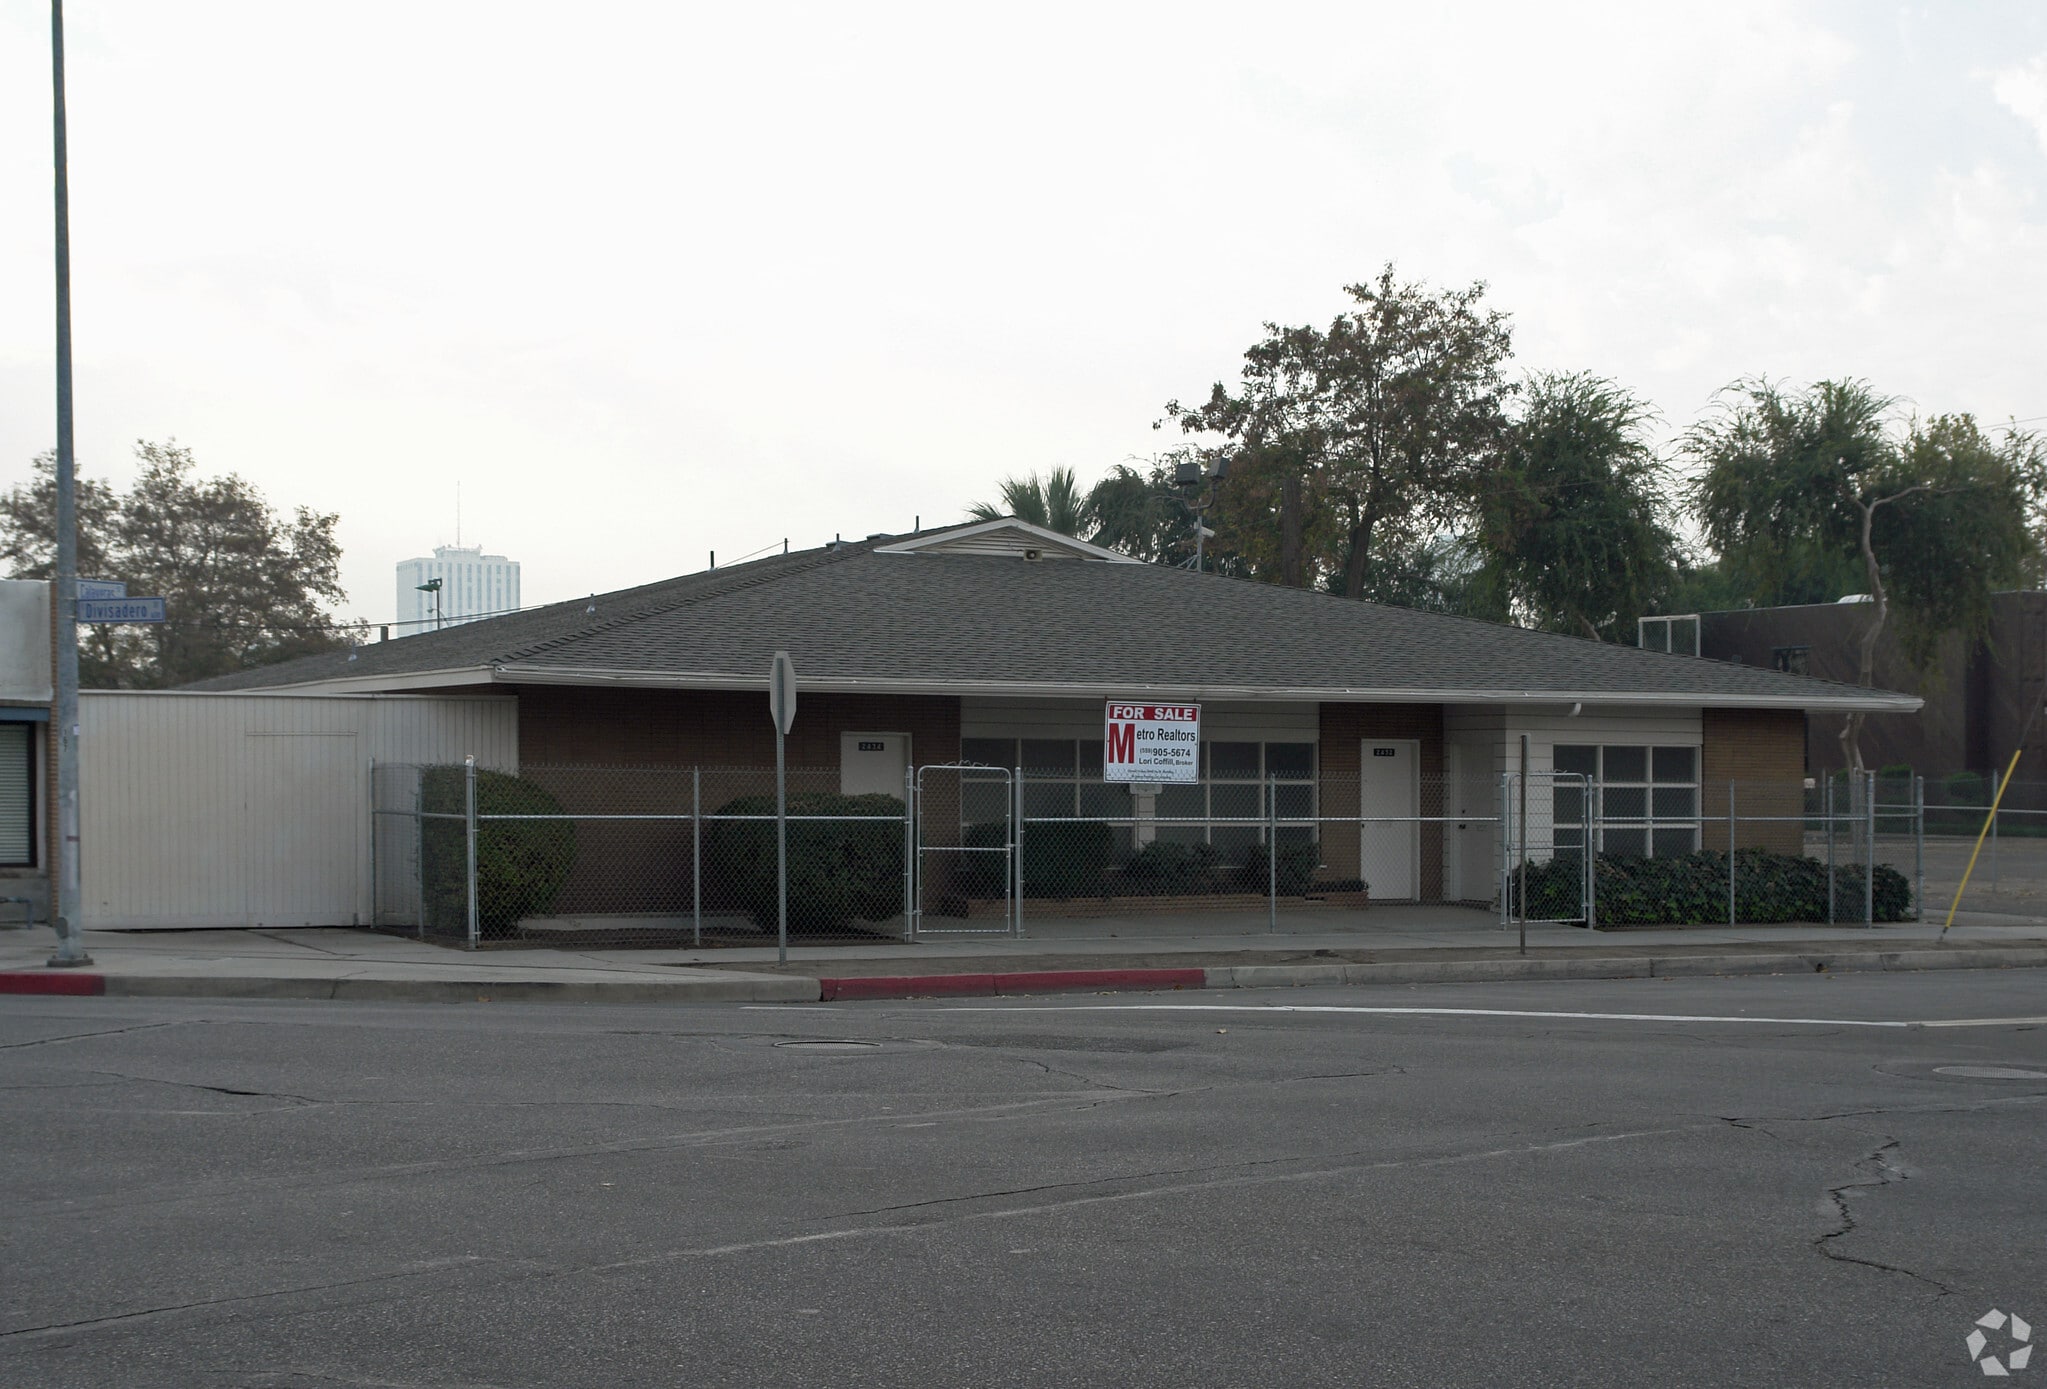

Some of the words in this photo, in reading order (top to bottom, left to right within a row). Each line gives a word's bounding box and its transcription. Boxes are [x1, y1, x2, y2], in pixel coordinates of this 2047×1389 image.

[86, 603, 147, 618] Divisadero
[1113, 706, 1144, 719] FOR
[1154, 708, 1193, 721] SALE
[1157, 728, 1196, 742] Realtors
[1152, 748, 1191, 758] 905-5674
[1138, 757, 1153, 765] Lori
